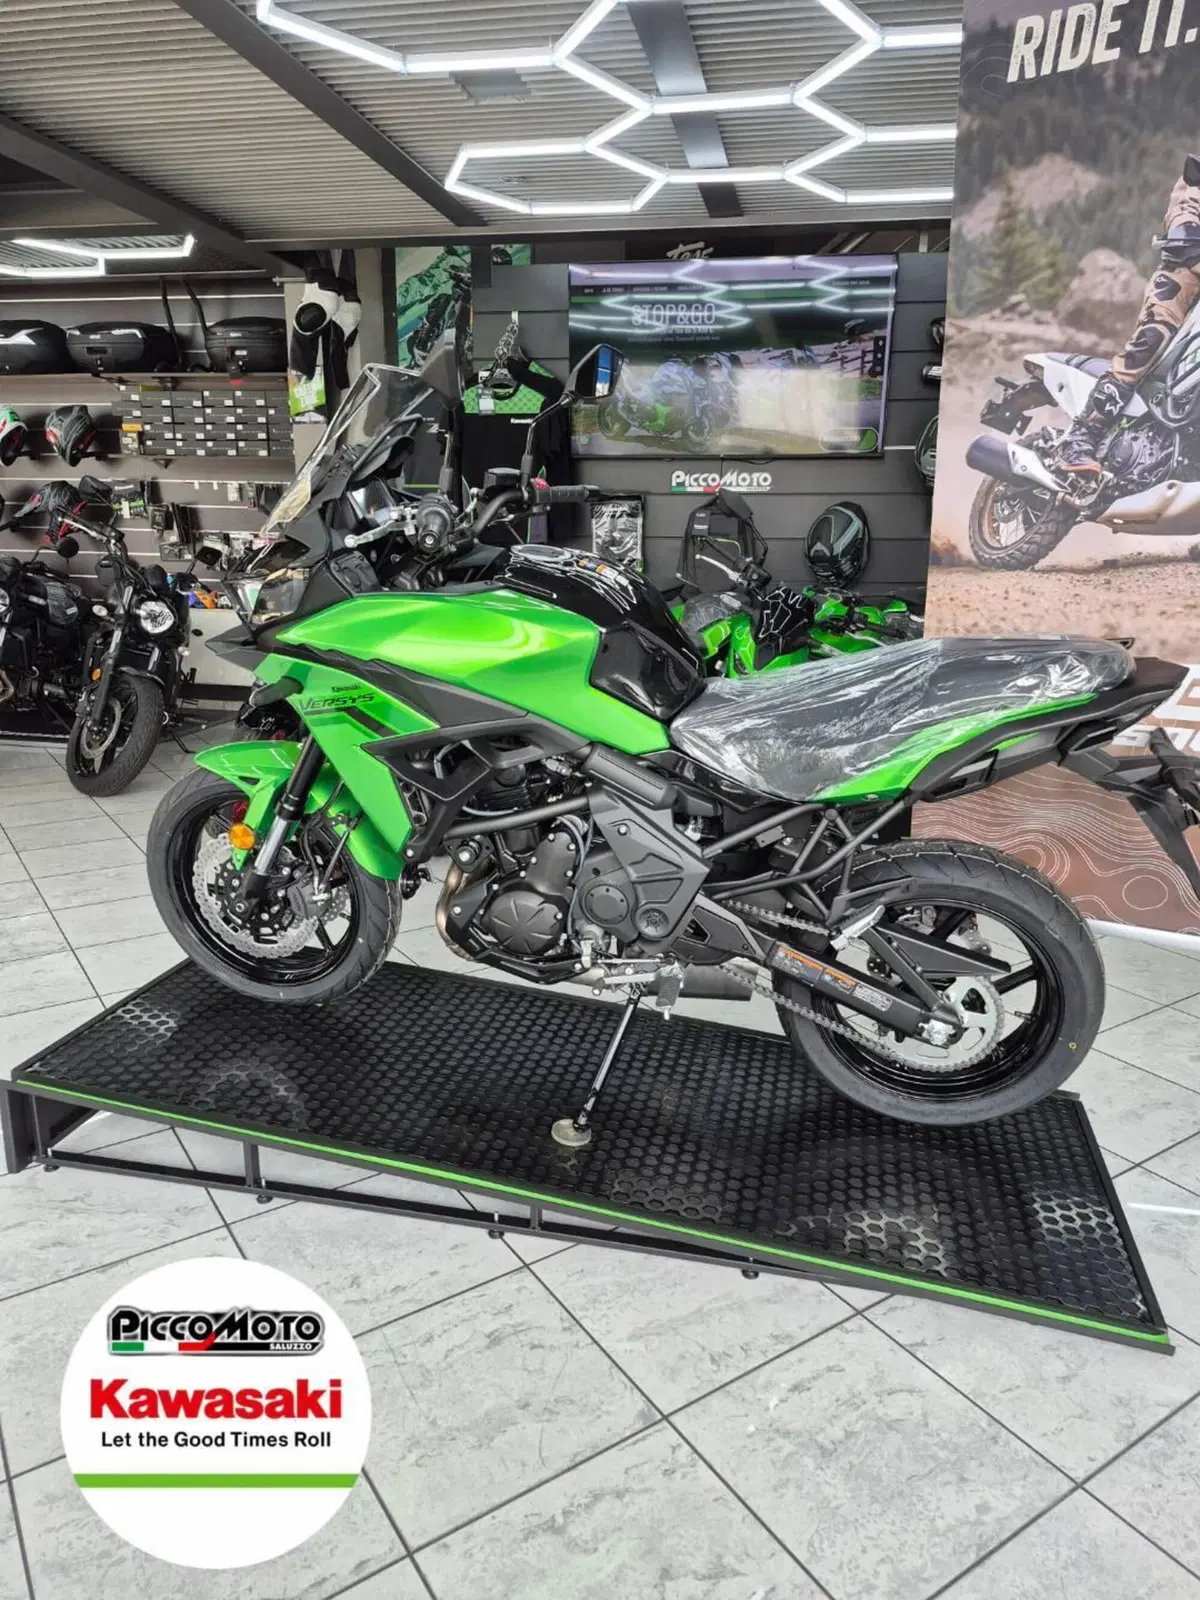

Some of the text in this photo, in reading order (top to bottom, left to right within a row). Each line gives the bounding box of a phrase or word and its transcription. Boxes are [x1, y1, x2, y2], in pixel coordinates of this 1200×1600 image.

[1007, 0, 1129, 83] RIDE
[631, 303, 716, 326] STOP&GO
[671, 469, 772, 487] PICCOMOTO
[299, 692, 375, 711] VERSYS
